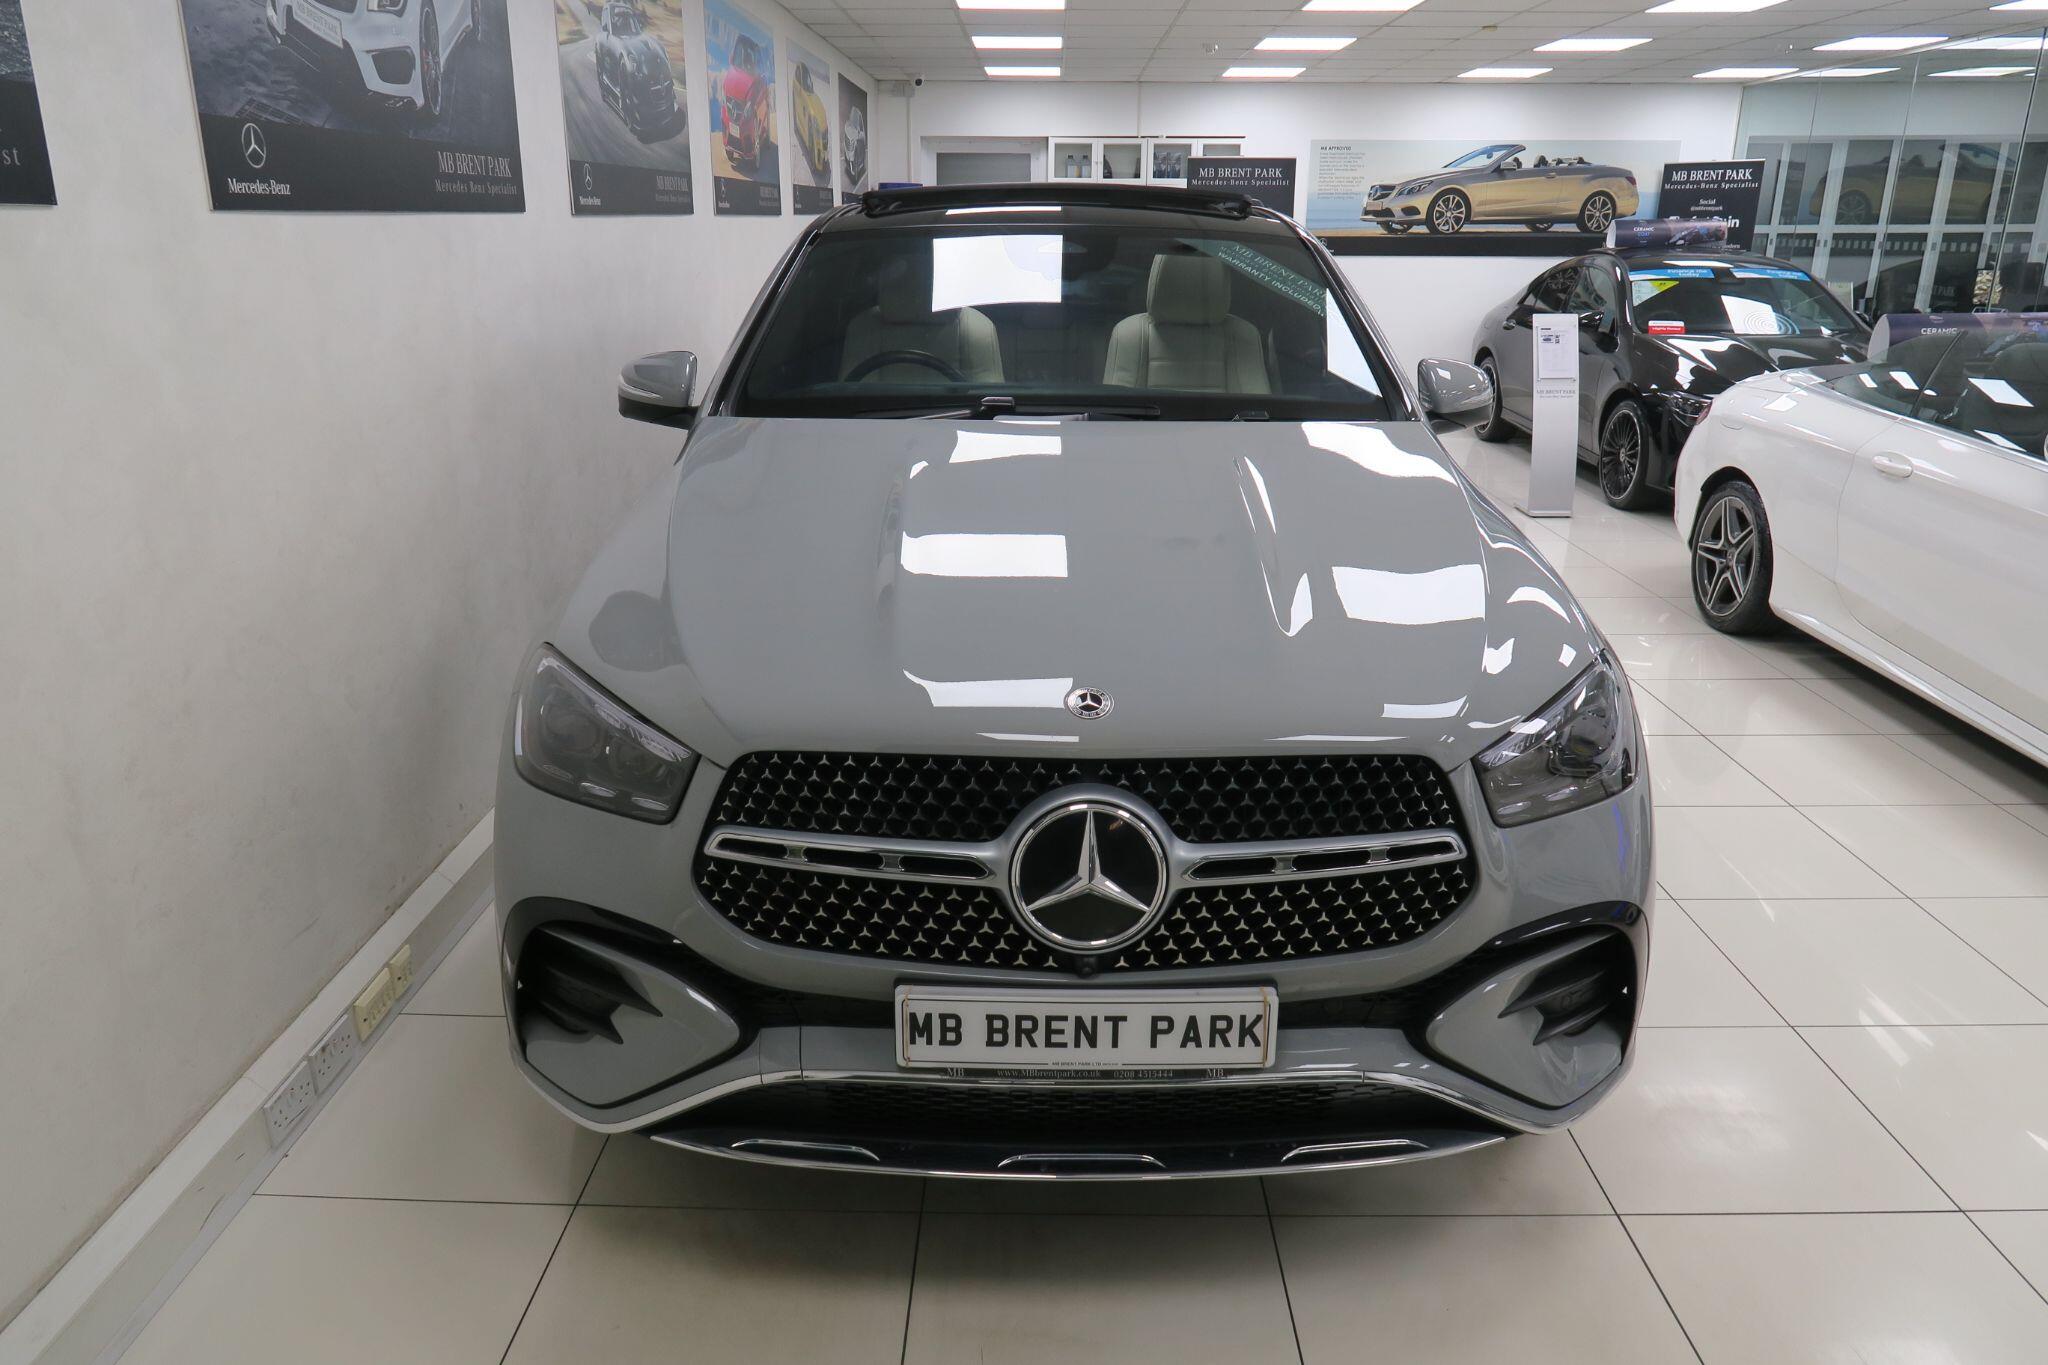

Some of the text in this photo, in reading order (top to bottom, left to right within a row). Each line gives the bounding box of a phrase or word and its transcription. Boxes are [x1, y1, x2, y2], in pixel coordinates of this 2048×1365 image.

[437, 151, 512, 178] MB BRENT PARK
[1199, 168, 1282, 178] MB BRENT PARK
[1251, 179, 1289, 187] Specialist
[1672, 168, 1752, 181] MB BRENT PARK
[228, 178, 291, 195] Mercedes-Benz
[435, 179, 467, 193] Mercedes
[487, 181, 518, 196] Specialist
[1721, 182, 1759, 190] Specialist
[1218, 252, 1270, 281] WARRANTY
[1254, 256, 1298, 280] BRENT
[909, 1012, 1264, 1048] MB BRENT PARK
[947, 1068, 965, 1078] MB
[996, 1068, 1101, 1080] www.MBbrentpark.co.uk
[1114, 1070, 1134, 1078] 0208
[1206, 1068, 1225, 1078] MB
